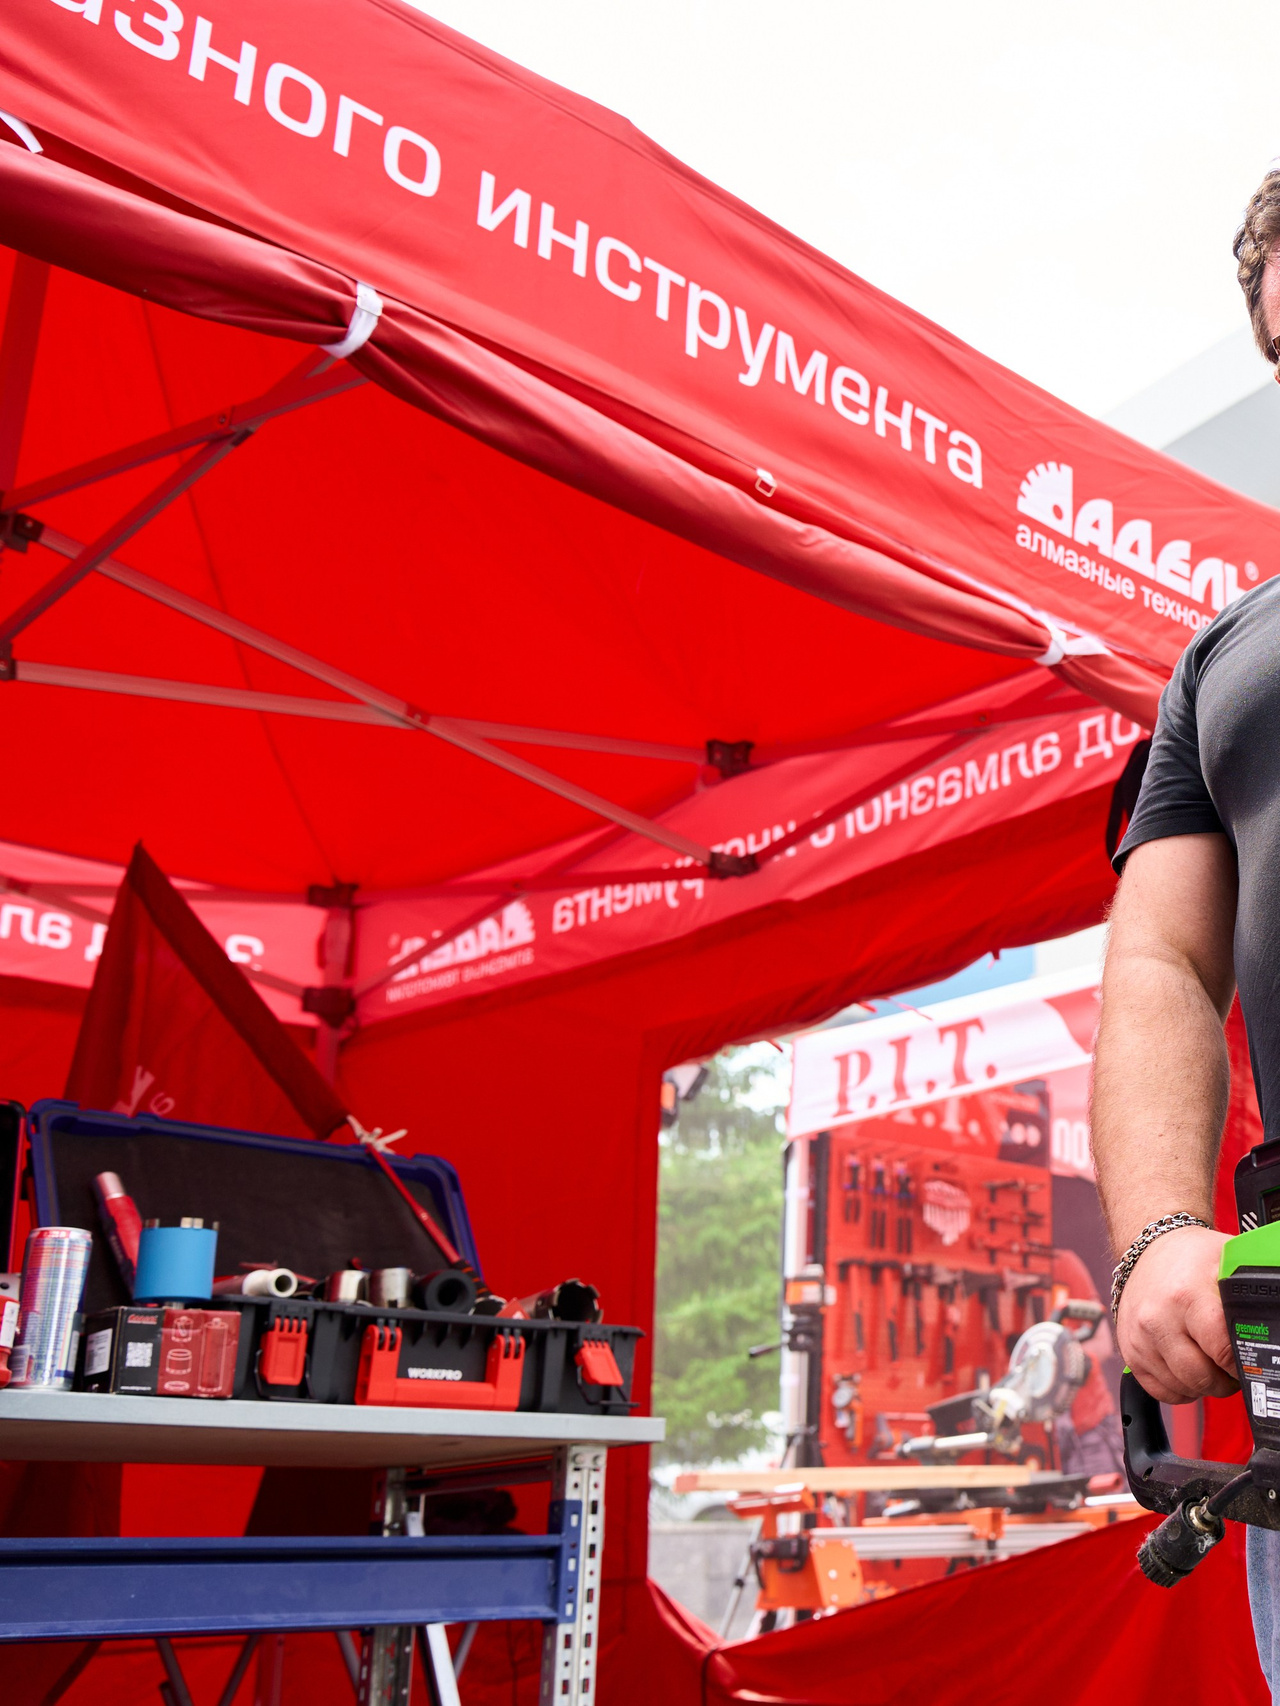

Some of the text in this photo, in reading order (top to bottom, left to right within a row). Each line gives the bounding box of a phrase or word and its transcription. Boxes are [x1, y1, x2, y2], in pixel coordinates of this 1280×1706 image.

[52, 0, 984, 489] зного инструмента
[1015, 524, 1136, 600] алмазные
[831, 1017, 997, 1119] P.I.T.
[1235, 1322, 1270, 1336] greenworks
[407, 1367, 463, 1382] WORKPRO
